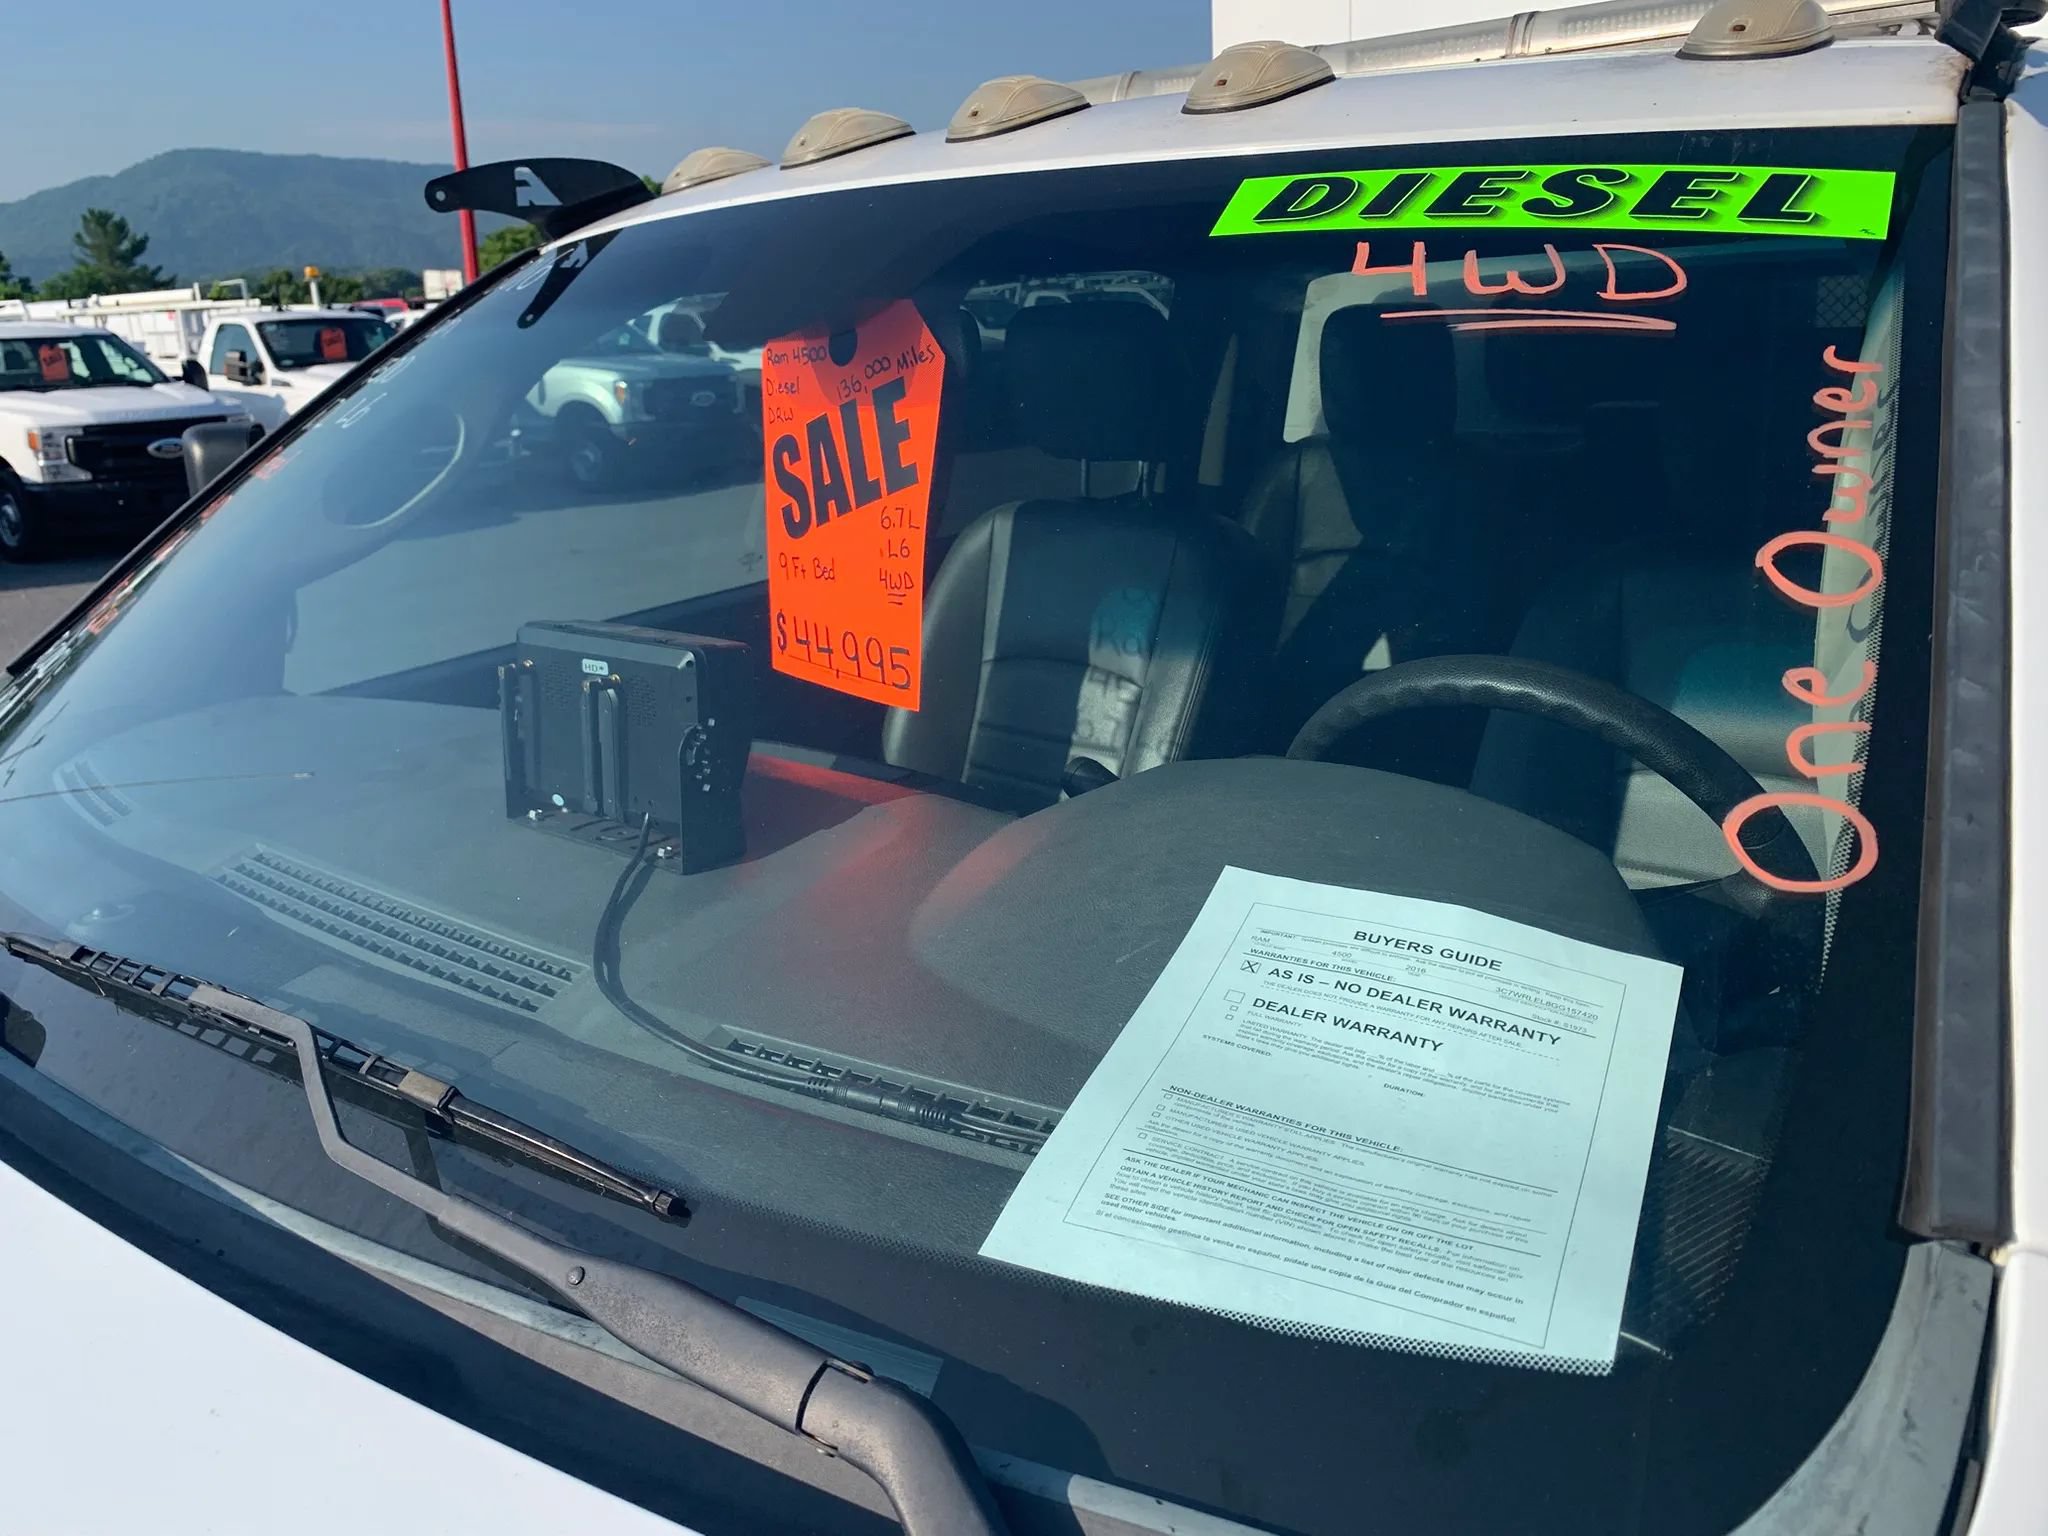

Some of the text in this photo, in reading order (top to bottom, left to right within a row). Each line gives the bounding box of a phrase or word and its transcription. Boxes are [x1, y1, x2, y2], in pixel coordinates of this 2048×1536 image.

[1253, 168, 1820, 226] DIESEL
[1352, 241, 1687, 300] 4WD
[766, 344, 828, 366] Ram 4500
[836, 345, 936, 400] 136,000 Miles
[766, 376, 801, 396] Diesel
[768, 407, 795, 425] DRW
[772, 376, 920, 541] SALE
[880, 506, 921, 532] 6.7L
[779, 551, 836, 582] 9 Ft Bed
[879, 568, 915, 592] 4WD
[1722, 345, 1885, 893] One Owner
[775, 608, 911, 691] $44,995
[1248, 947, 1309, 964] WARRANTIES
[1309, 959, 1330, 968] FOR
[1330, 963, 1352, 972] THIS
[1249, 934, 1271, 943] RAM
[1330, 949, 1353, 958] 4500
[1352, 929, 1435, 956] BUYERS
[1437, 947, 1503, 971] GUIDE
[1404, 963, 1427, 974] 2016
[1251, 997, 1328, 1023] DEALER
[1329, 1015, 1444, 1052] WARRANTY
[1267, 966, 1295, 980] AS
[1296, 972, 1316, 984] IS
[1333, 979, 1363, 994] NO
[1365, 986, 1444, 1014] DEALER
[1445, 1005, 1562, 1046] WARRANTY
[1201, 1033, 1236, 1047] SYSTEMS
[1168, 1084, 1234, 1108] NON-DEALER
[1233, 1103, 1303, 1127] WARRANTIES
[1303, 1122, 1327, 1134] FOR
[1328, 1128, 1353, 1140] THIS
[1099, 1198, 1121, 1208] used
[1119, 1203, 1144, 1214] motor
[1118, 1164, 1150, 1177] OBTAIN
[1156, 1173, 1193, 1187] VEHICLE
[1192, 1182, 1230, 1197] HISTORY
[1228, 1192, 1265, 1207] REPORT
[1264, 1201, 1285, 1212] AND
[1284, 1207, 1315, 1221] CHECK
[1315, 1216, 1336, 1227] FOR
[1335, 1221, 1362, 1233] OPEN
[1361, 1228, 1397, 1242] SAFETY
[1123, 1155, 1142, 1165] ASK
[1141, 1159, 1160, 1169] THE
[1158, 1164, 1191, 1177] DEALER
[1190, 1172, 1201, 1180] IF
[1200, 1175, 1226, 1187] YOUR
[1225, 1181, 1271, 1199] MECHANIC
[1270, 1194, 1291, 1204] CAN
[1289, 1199, 1327, 1214] INSPECT
[1328, 1209, 1346, 1219] THE
[1345, 1214, 1385, 1229] VEHICLE
[1384, 1224, 1400, 1233] ON
[1400, 1227, 1414, 1237] OR
[1414, 1231, 1434, 1242] OFF
[1435, 1236, 1455, 1247] THE
[1102, 1210, 1113, 1219] el
[1166, 1226, 1203, 1240] gestiona
[1201, 1234, 1212, 1243] la
[1210, 1236, 1235, 1248] venta
[1234, 1242, 1247, 1252] en
[1309, 1262, 1327, 1273] una
[1327, 1267, 1353, 1280] copia
[1352, 1274, 1365, 1283] de
[1364, 1277, 1375, 1286] la
[1397, 1285, 1413, 1296] del
[1412, 1289, 1464, 1310] Comprador
[1464, 1303, 1478, 1314] en
[1103, 1191, 1121, 1201] SEE
[1119, 1195, 1151, 1208] OTHER
[1148, 1202, 1170, 1213] SIDE
[1169, 1207, 1183, 1216] for
[1182, 1210, 1222, 1226] important
[1220, 1220, 1263, 1237] additional
[1312, 1244, 1352, 1261] including
[1359, 1257, 1375, 1267] list
[1374, 1261, 1386, 1270] of
[1385, 1263, 1412, 1277] major
[1411, 1270, 1446, 1285] defects
[1445, 1279, 1465, 1290] that
[1464, 1284, 1486, 1296] may
[1486, 1289, 1513, 1303] occur
[1514, 1297, 1524, 1306] in
